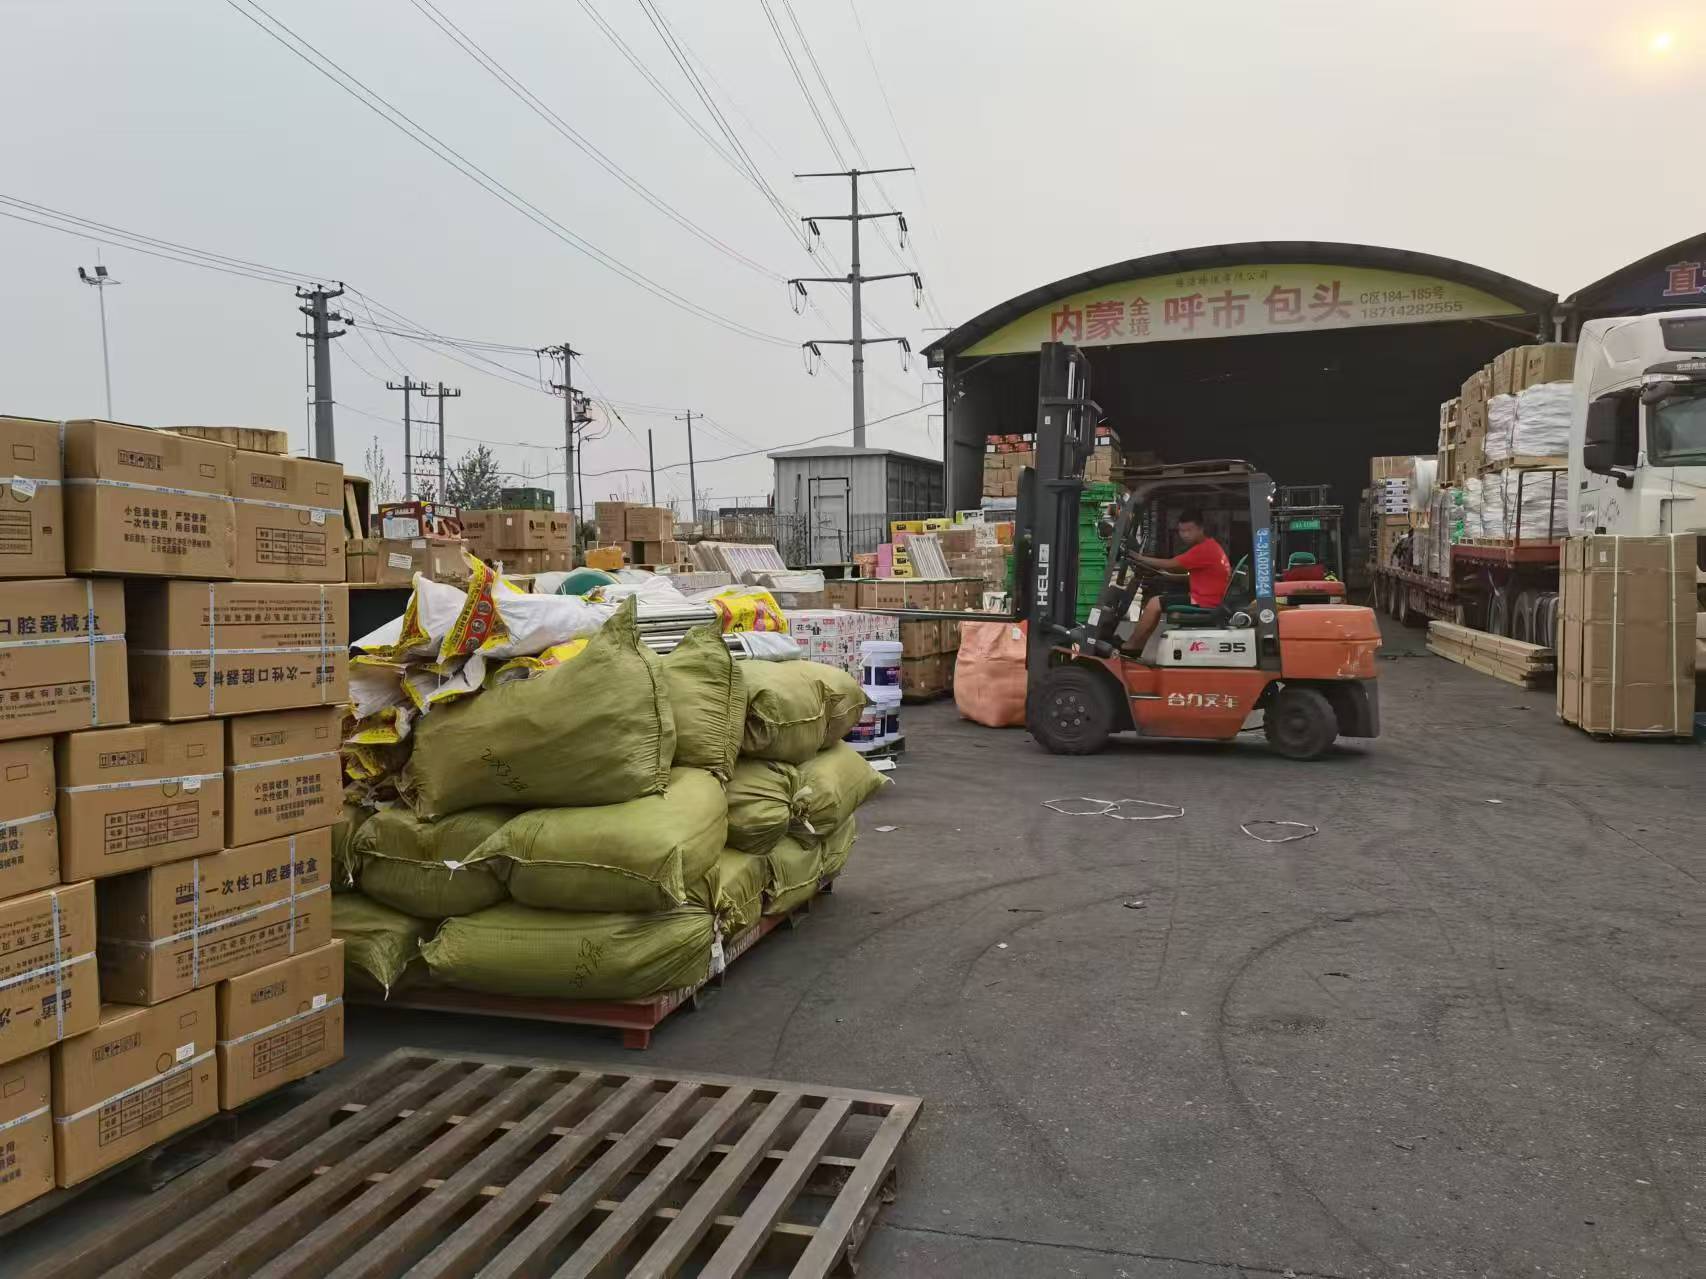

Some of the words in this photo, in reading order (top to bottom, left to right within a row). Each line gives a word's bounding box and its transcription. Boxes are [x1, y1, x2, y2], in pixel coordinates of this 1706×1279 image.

[1662, 260, 1706, 297] 直
[1050, 300, 1126, 342] 内蒙
[1129, 296, 1151, 337] 全境
[1164, 289, 1250, 332] 呼市
[1263, 280, 1353, 325] 包头
[1361, 300, 1464, 319] 18714282555
[1219, 643, 1246, 652] 35
[1168, 692, 1239, 708] 合力叉车
[206, 857, 318, 895] 一次性口腔器械盒
